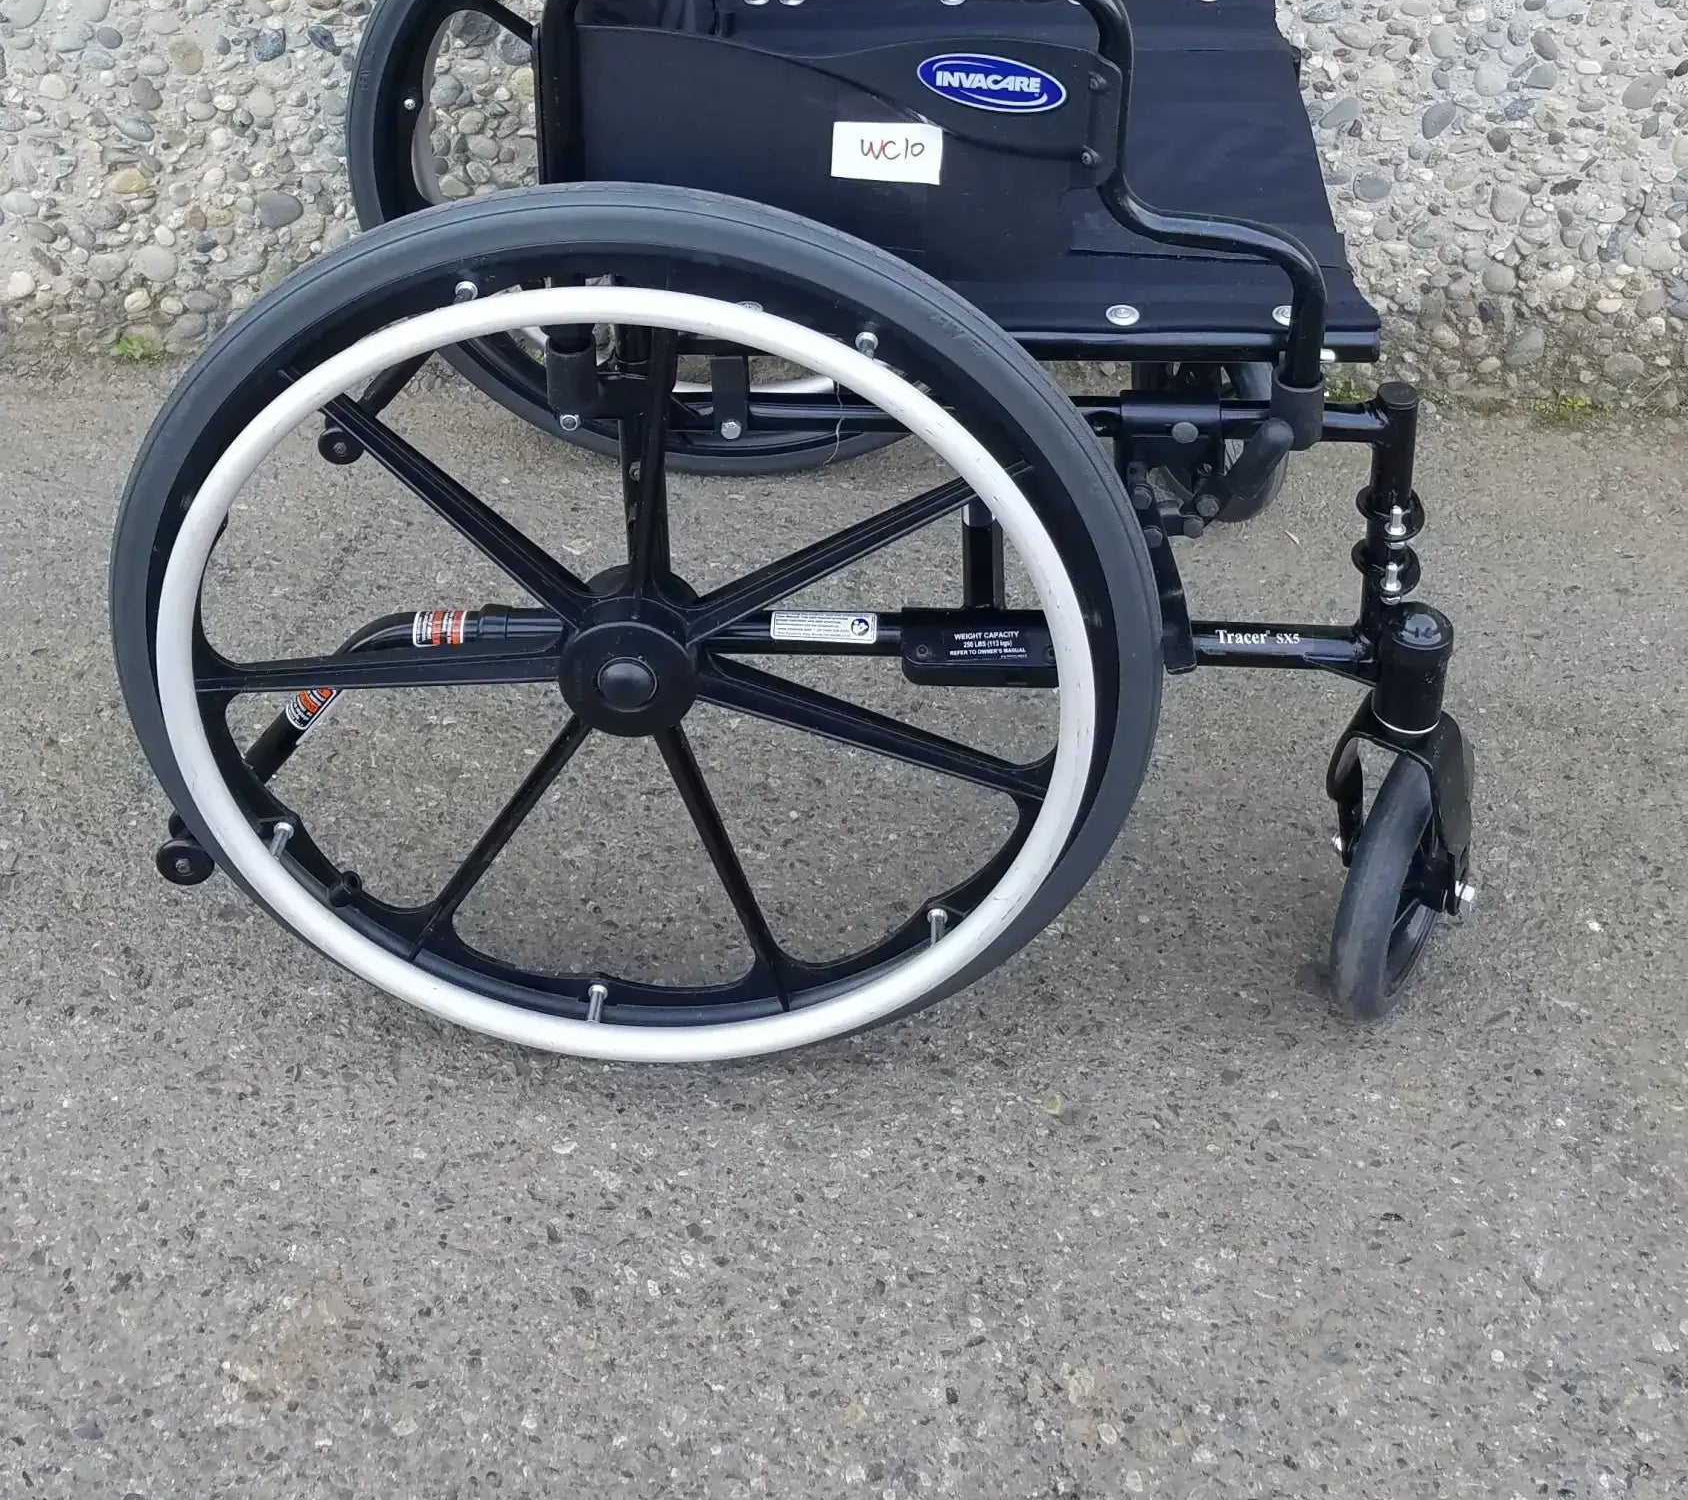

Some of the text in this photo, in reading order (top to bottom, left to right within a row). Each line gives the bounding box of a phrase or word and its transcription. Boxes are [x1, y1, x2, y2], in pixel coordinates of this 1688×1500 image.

[935, 71, 1041, 93] INVACARE
[954, 632, 982, 640] WEIGHT
[1215, 629, 1300, 644] Tracer SX5
[974, 640, 986, 648] LBS
